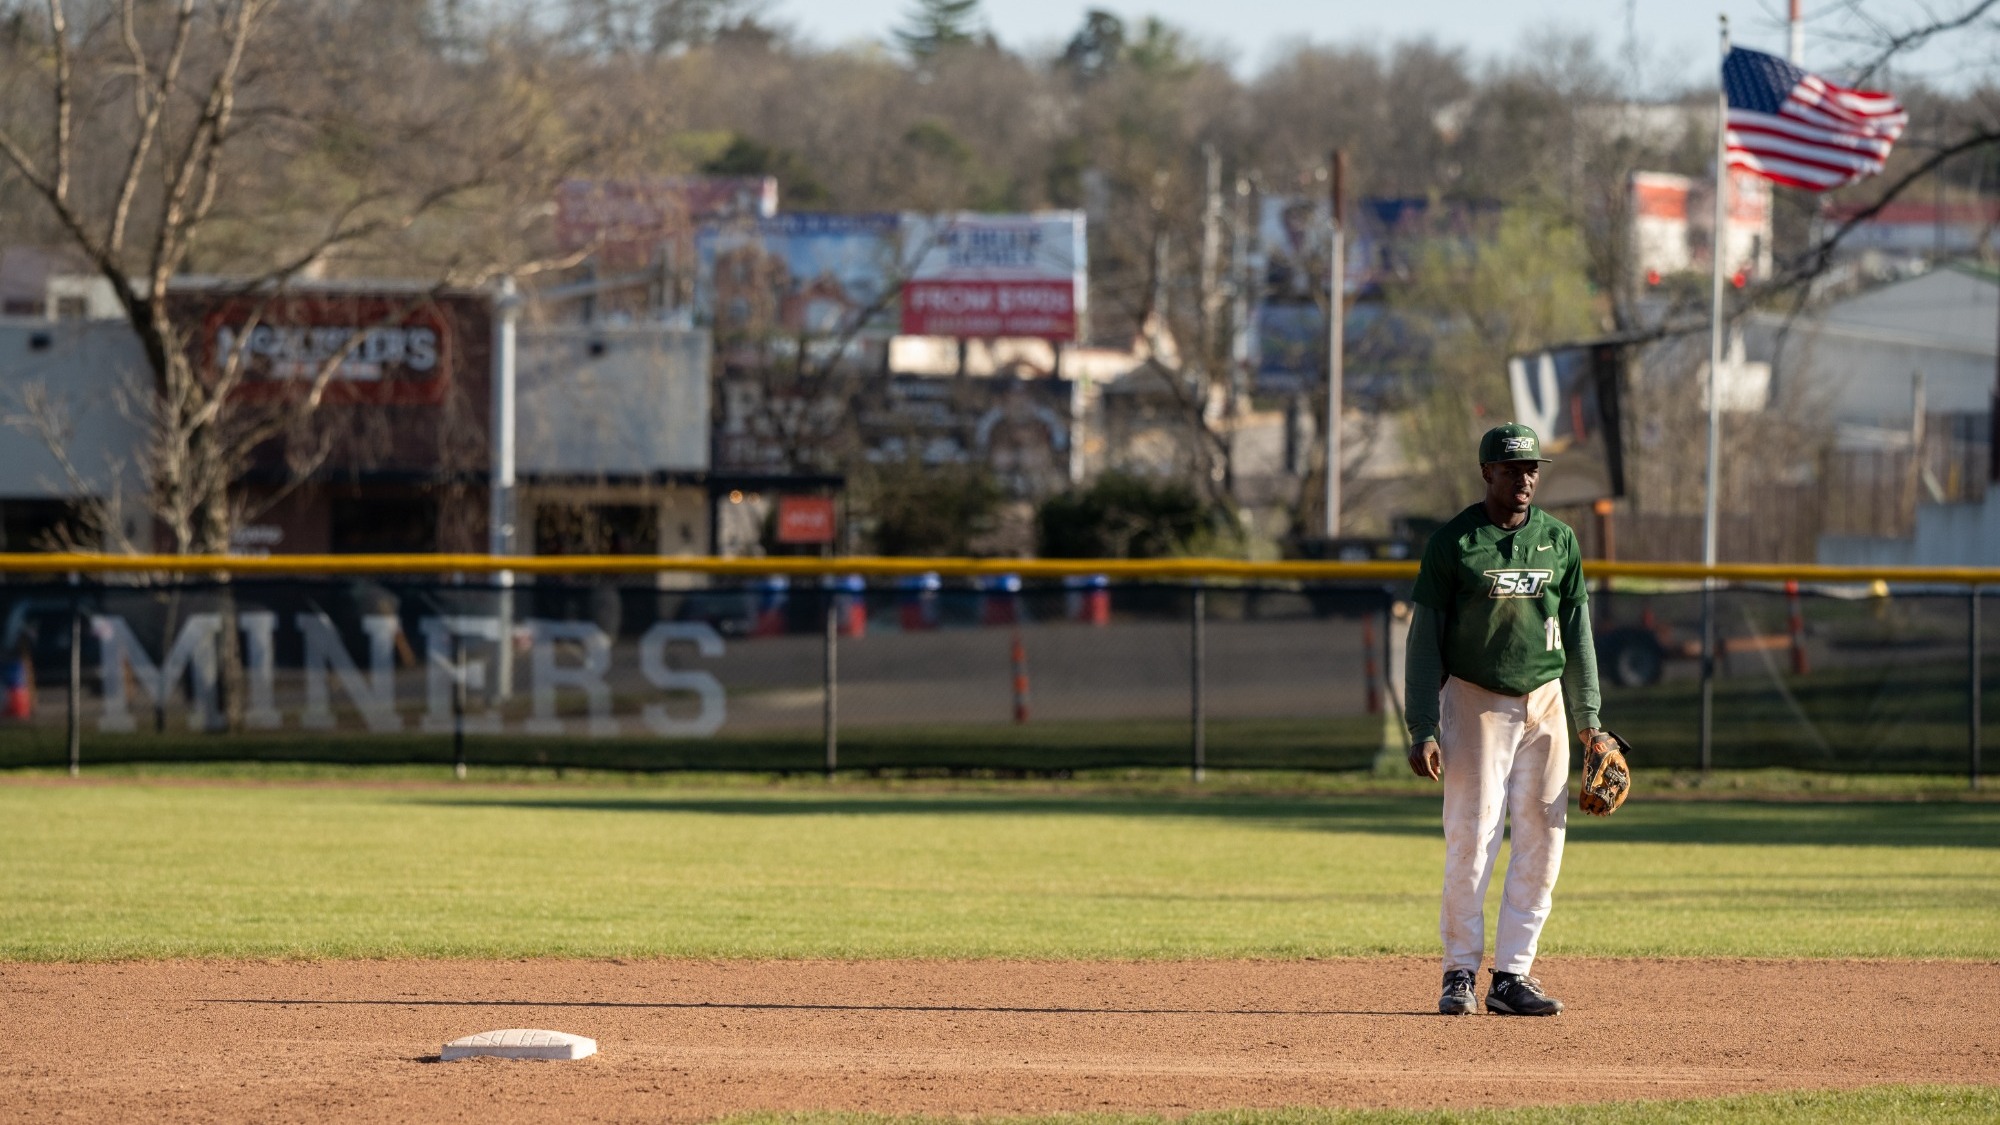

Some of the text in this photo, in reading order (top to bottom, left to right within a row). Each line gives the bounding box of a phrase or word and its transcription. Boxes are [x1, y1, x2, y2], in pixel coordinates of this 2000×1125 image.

[1505, 437, 1535, 451] S&T
[1491, 571, 1551, 596] S&T
[95, 612, 725, 738] MINERS
